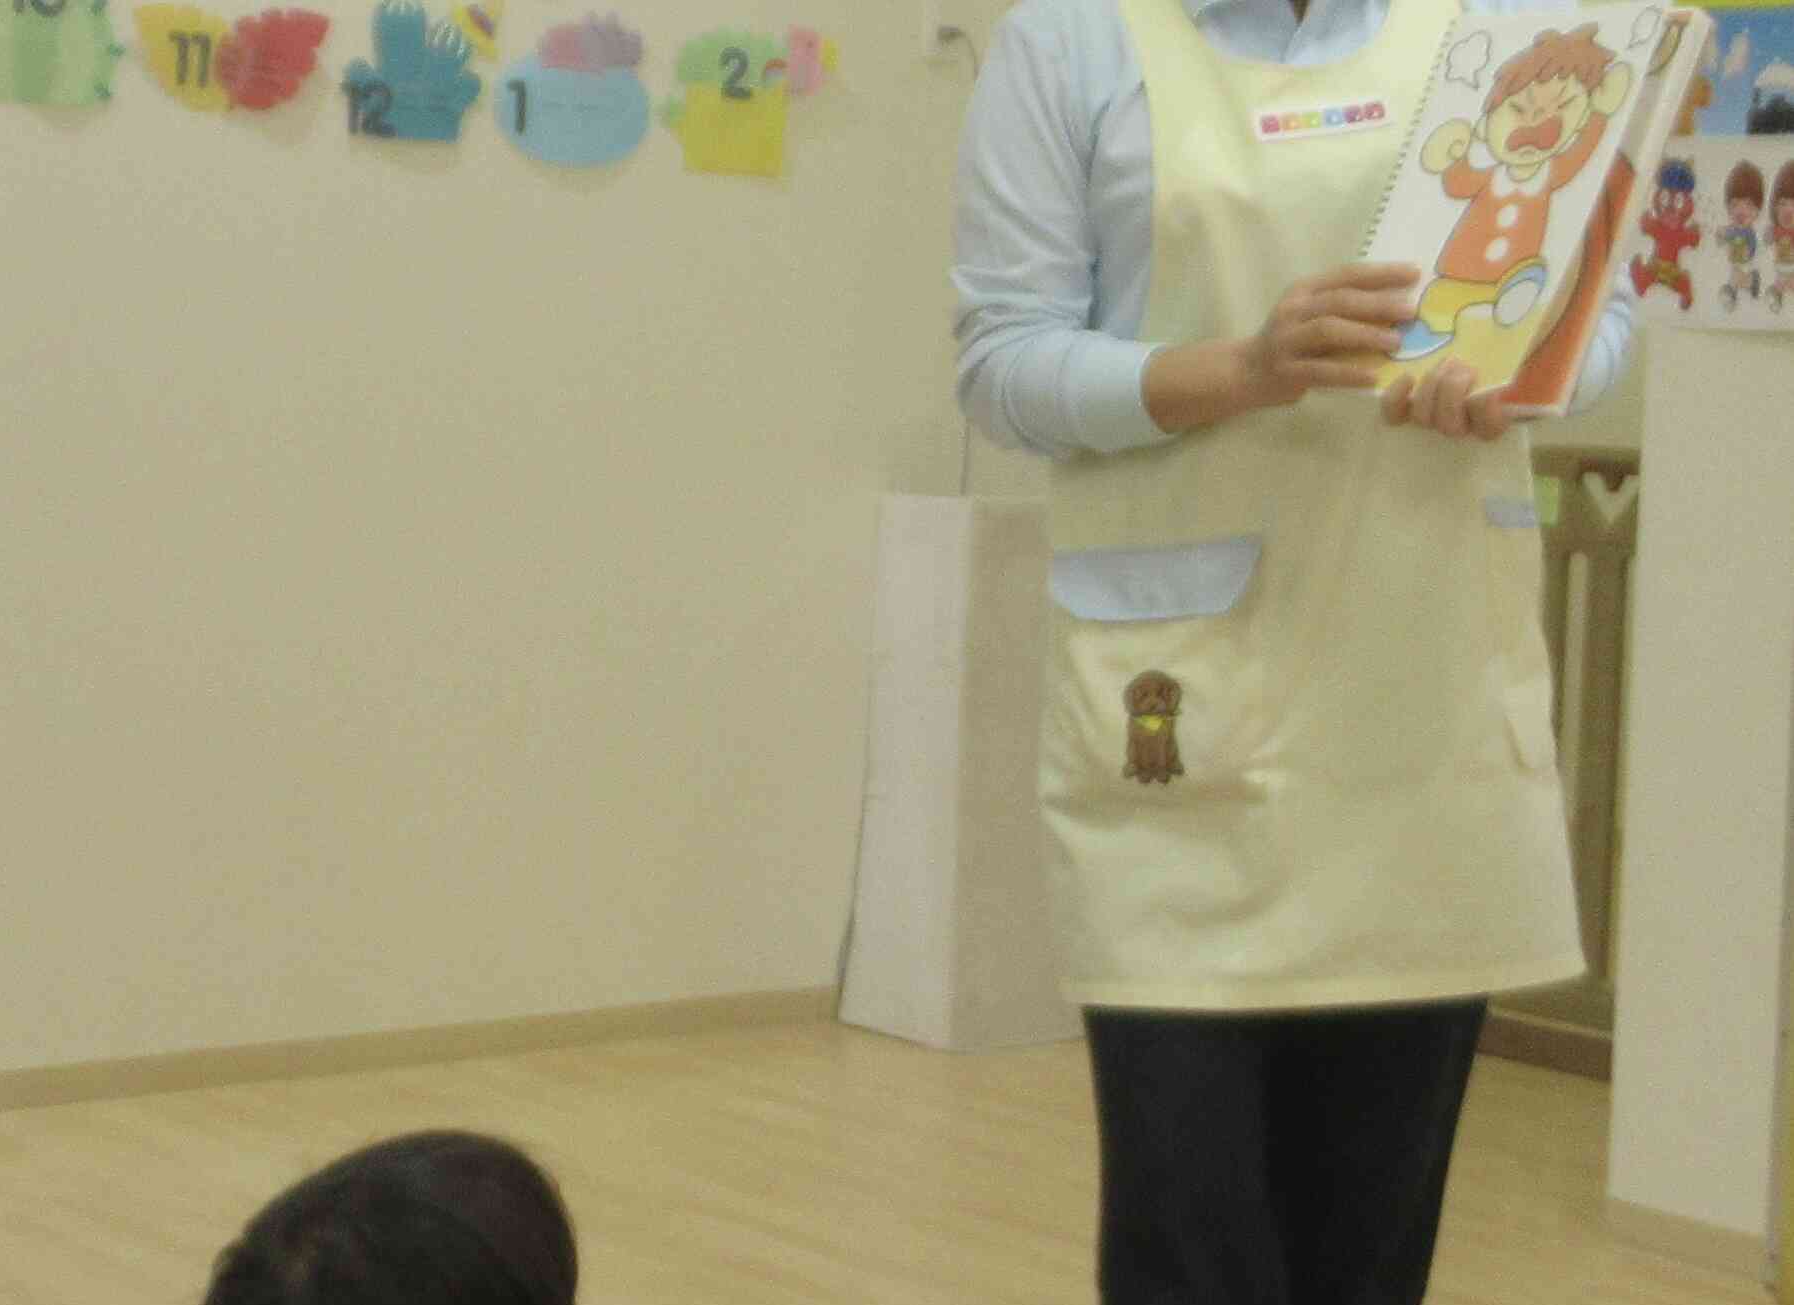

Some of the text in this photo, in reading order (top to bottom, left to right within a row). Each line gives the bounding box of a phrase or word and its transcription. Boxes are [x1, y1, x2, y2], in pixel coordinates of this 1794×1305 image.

[169, 31, 212, 88] 11
[719, 47, 750, 99] 2
[340, 79, 397, 138] 12
[508, 80, 527, 134] 1
